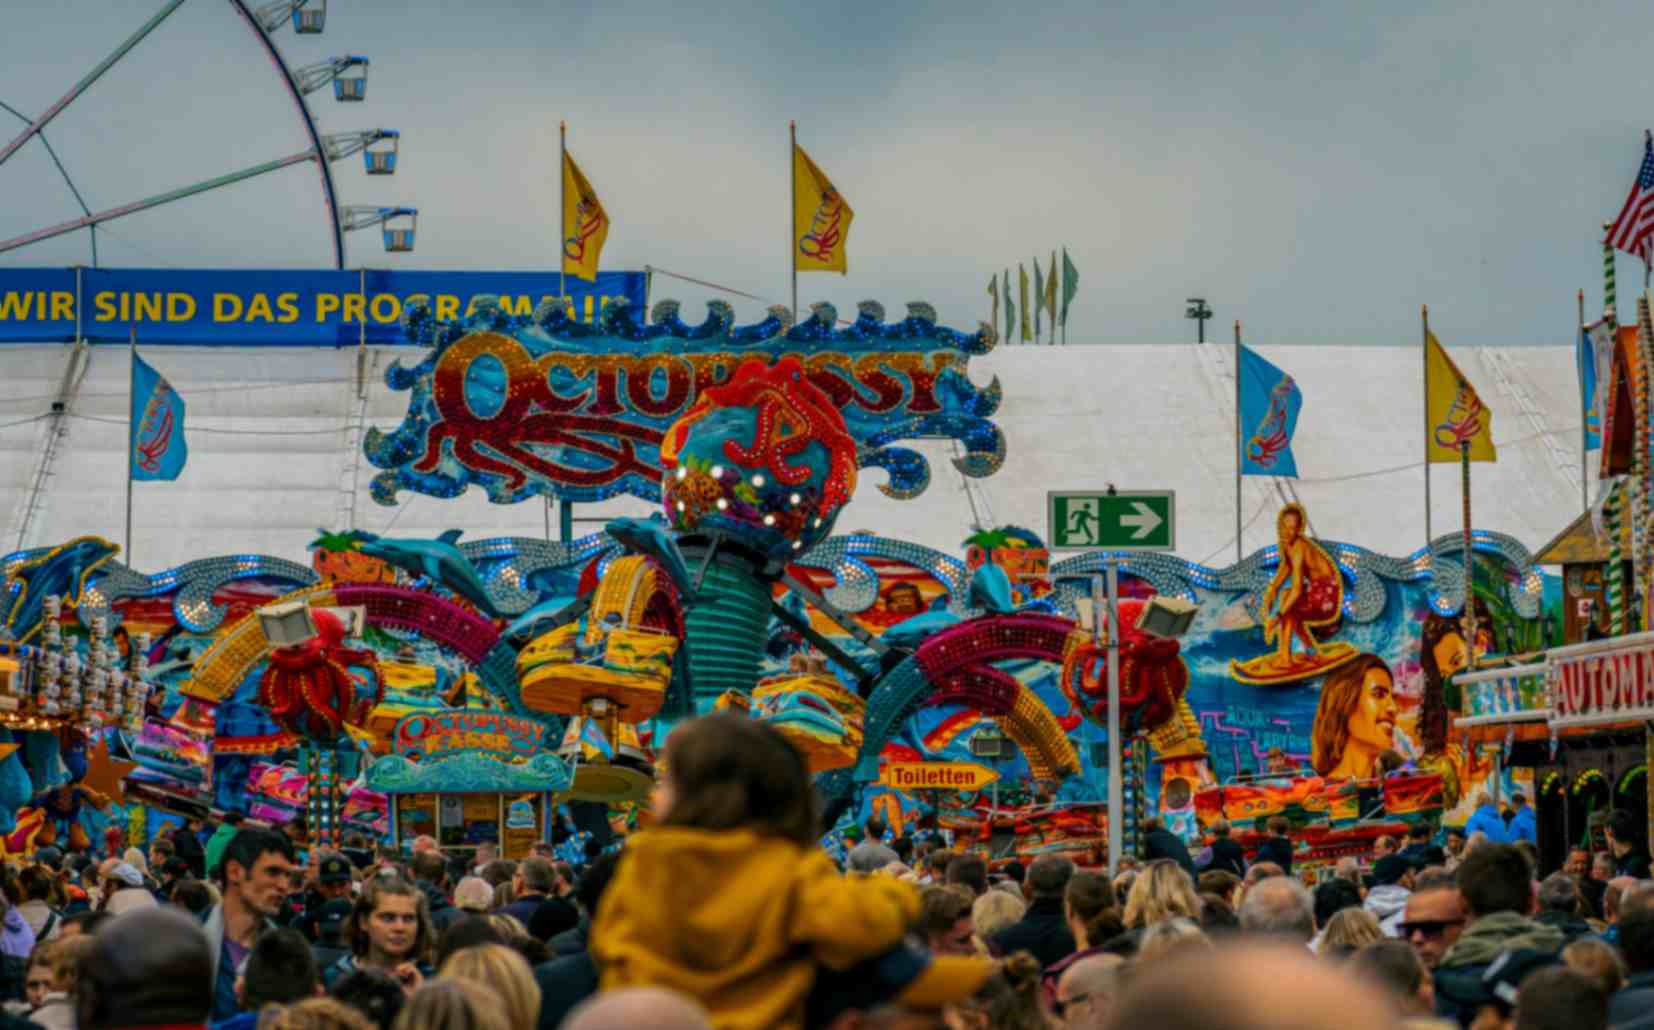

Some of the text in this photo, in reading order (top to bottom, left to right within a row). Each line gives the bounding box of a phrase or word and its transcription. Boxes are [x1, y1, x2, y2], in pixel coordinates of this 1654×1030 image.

[0, 291, 75, 321] WIR
[94, 291, 197, 322] SIND
[213, 292, 300, 323] DAS
[894, 767, 976, 785] Toiletten
